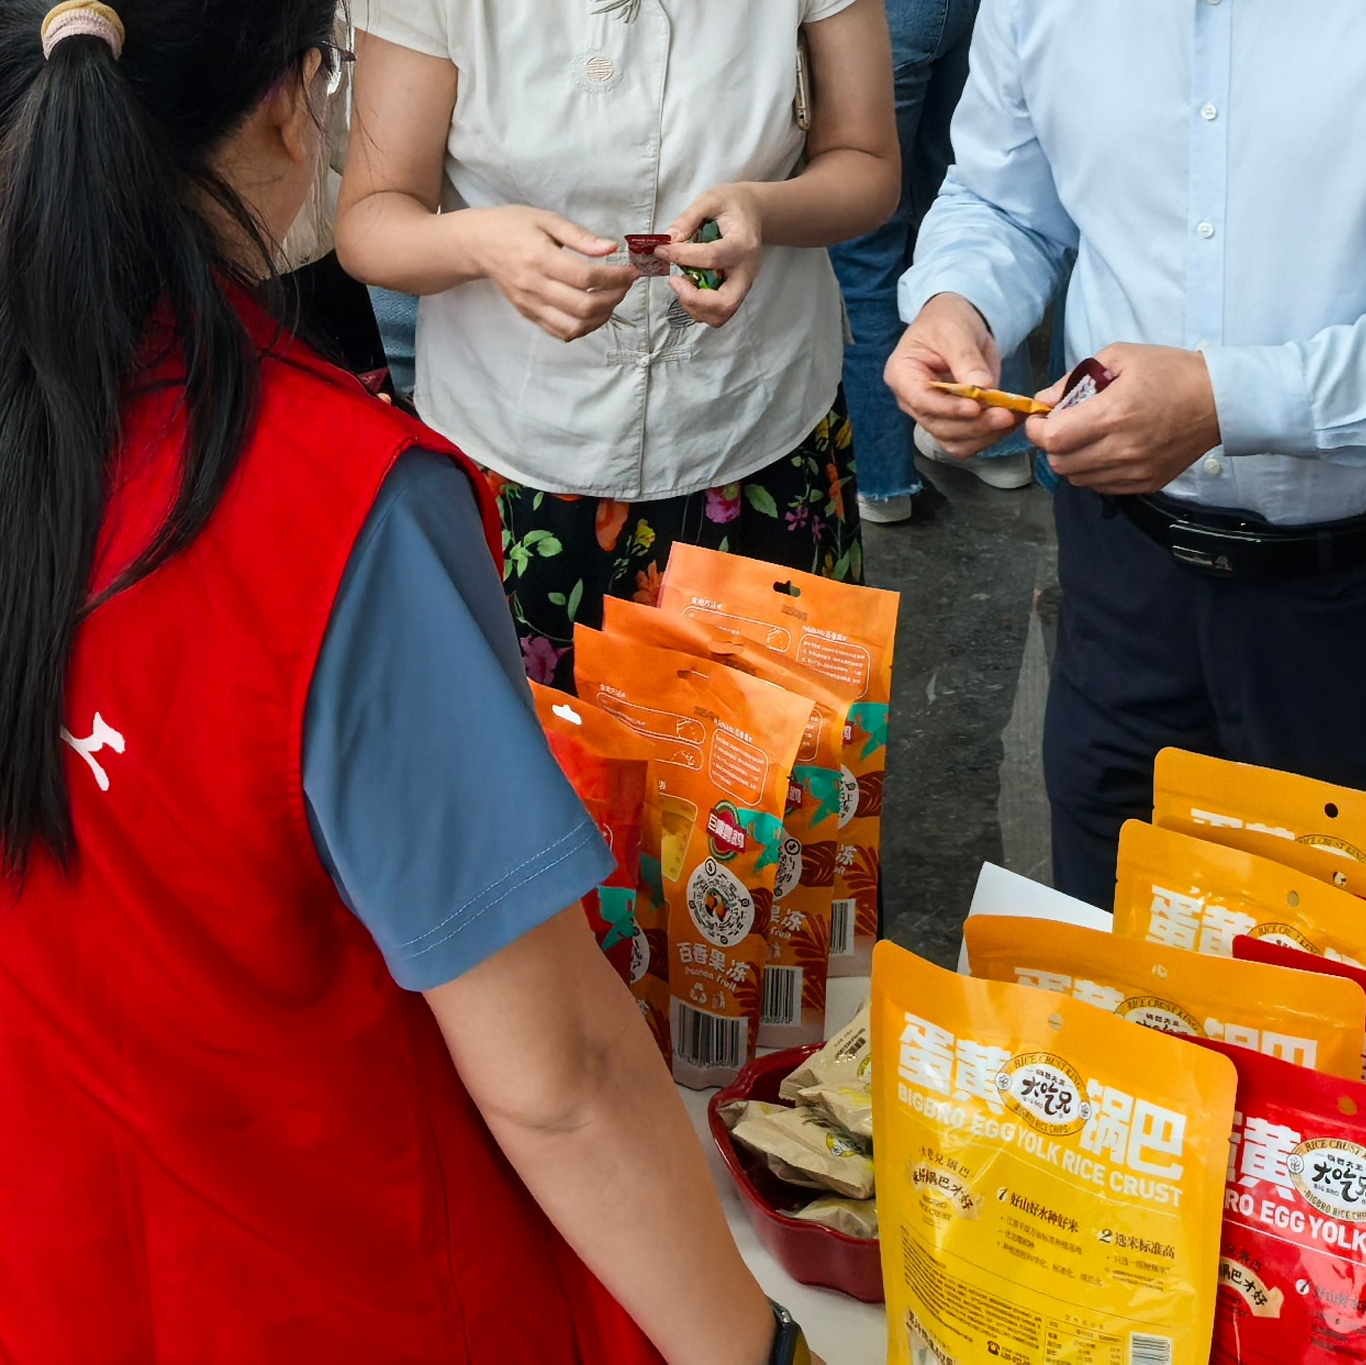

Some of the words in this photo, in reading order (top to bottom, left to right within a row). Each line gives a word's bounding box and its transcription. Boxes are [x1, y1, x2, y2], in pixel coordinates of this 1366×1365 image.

[898, 1012, 1013, 1115] 蛋黄
[1080, 1077, 1187, 1181] 锅巴
[1020, 1076, 1072, 1116] 大吃兄
[897, 1082, 967, 1129] BIGBRO
[972, 1113, 1017, 1142] EGG
[1015, 1126, 1060, 1167] YOLK
[1062, 1151, 1107, 1187] RICE
[1109, 1171, 1183, 1208] CRUST
[1304, 1139, 1328, 1153] RICE
[1329, 1141, 1363, 1155] CRUST
[1260, 1195, 1305, 1234] EGG
